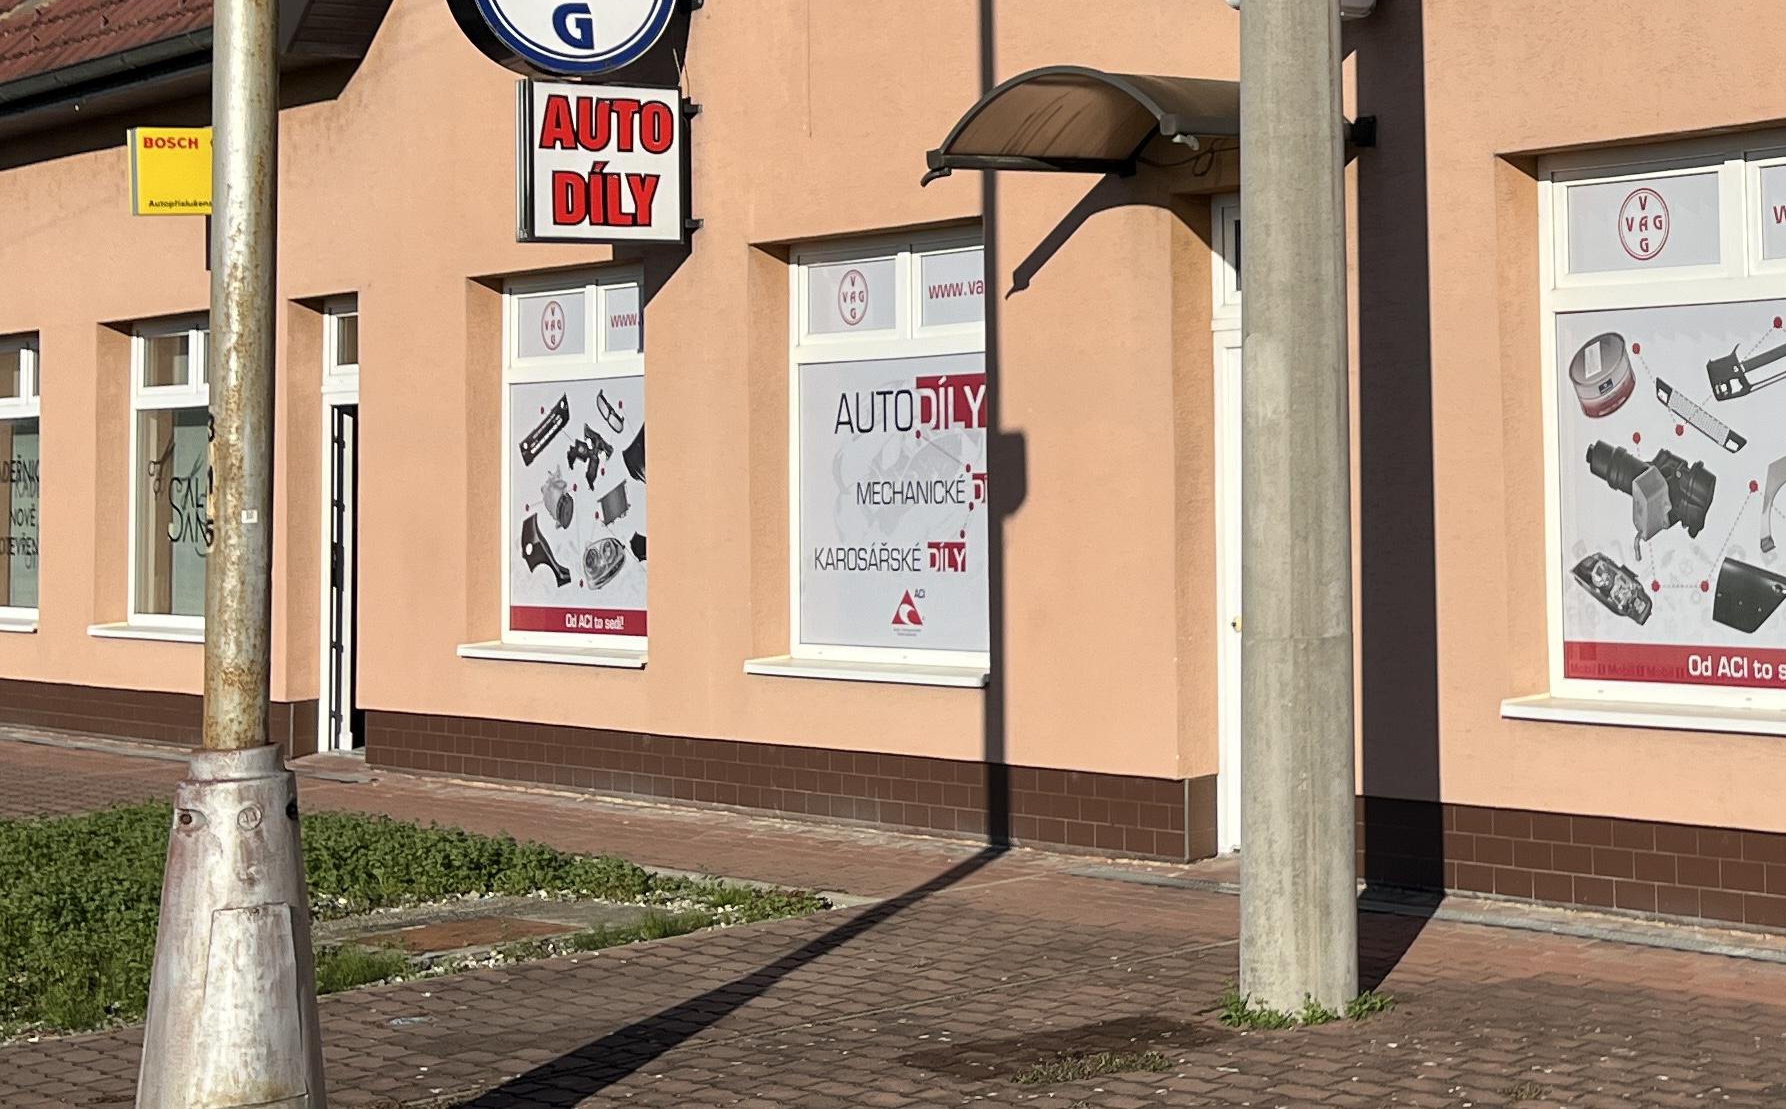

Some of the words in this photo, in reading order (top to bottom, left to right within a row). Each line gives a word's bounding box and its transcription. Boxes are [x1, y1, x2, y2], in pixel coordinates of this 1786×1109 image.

[539, 94, 675, 155] AUTO
[143, 137, 199, 149] BOSCH
[552, 161, 661, 228] DÍLY
[857, 473, 966, 505] MECHANICKÉ
[814, 542, 922, 572] KAROSÁŘSKÉ
[928, 542, 966, 572] DÍLY
[565, 613, 577, 628] Od
[578, 614, 593, 629] ACI
[594, 616, 603, 630] to
[1688, 654, 1713, 677] Od
[1717, 656, 1749, 679] ACI
[1752, 658, 1773, 679] to
